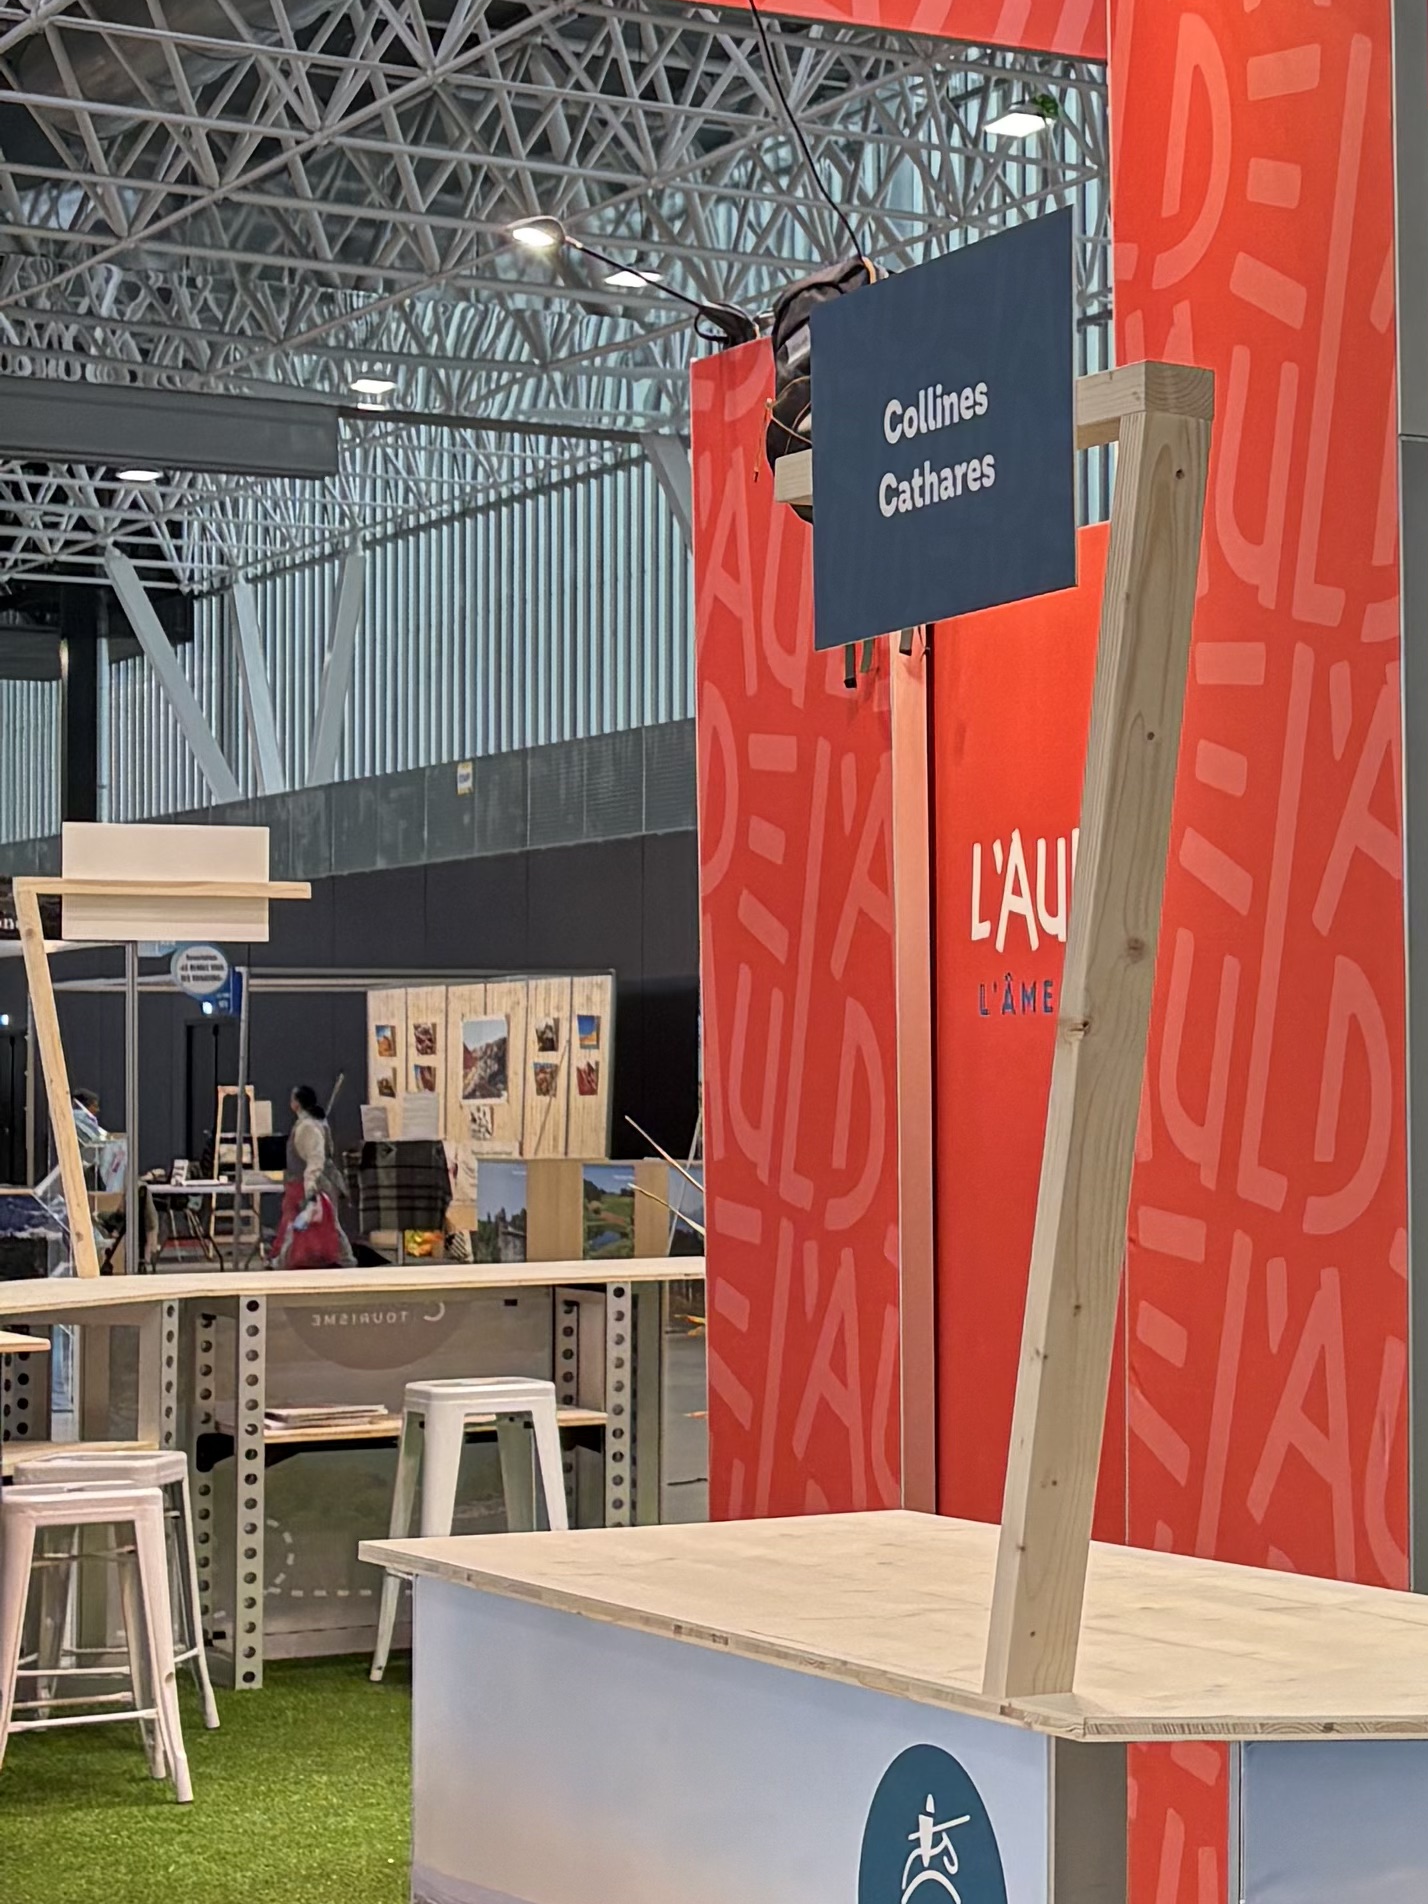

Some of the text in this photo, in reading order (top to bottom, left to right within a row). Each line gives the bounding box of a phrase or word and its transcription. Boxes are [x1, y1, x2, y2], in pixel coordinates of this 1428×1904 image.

[883, 381, 989, 445] Collines
[878, 453, 996, 518] Cathares
[978, 972, 1054, 1016] L'ÂME
